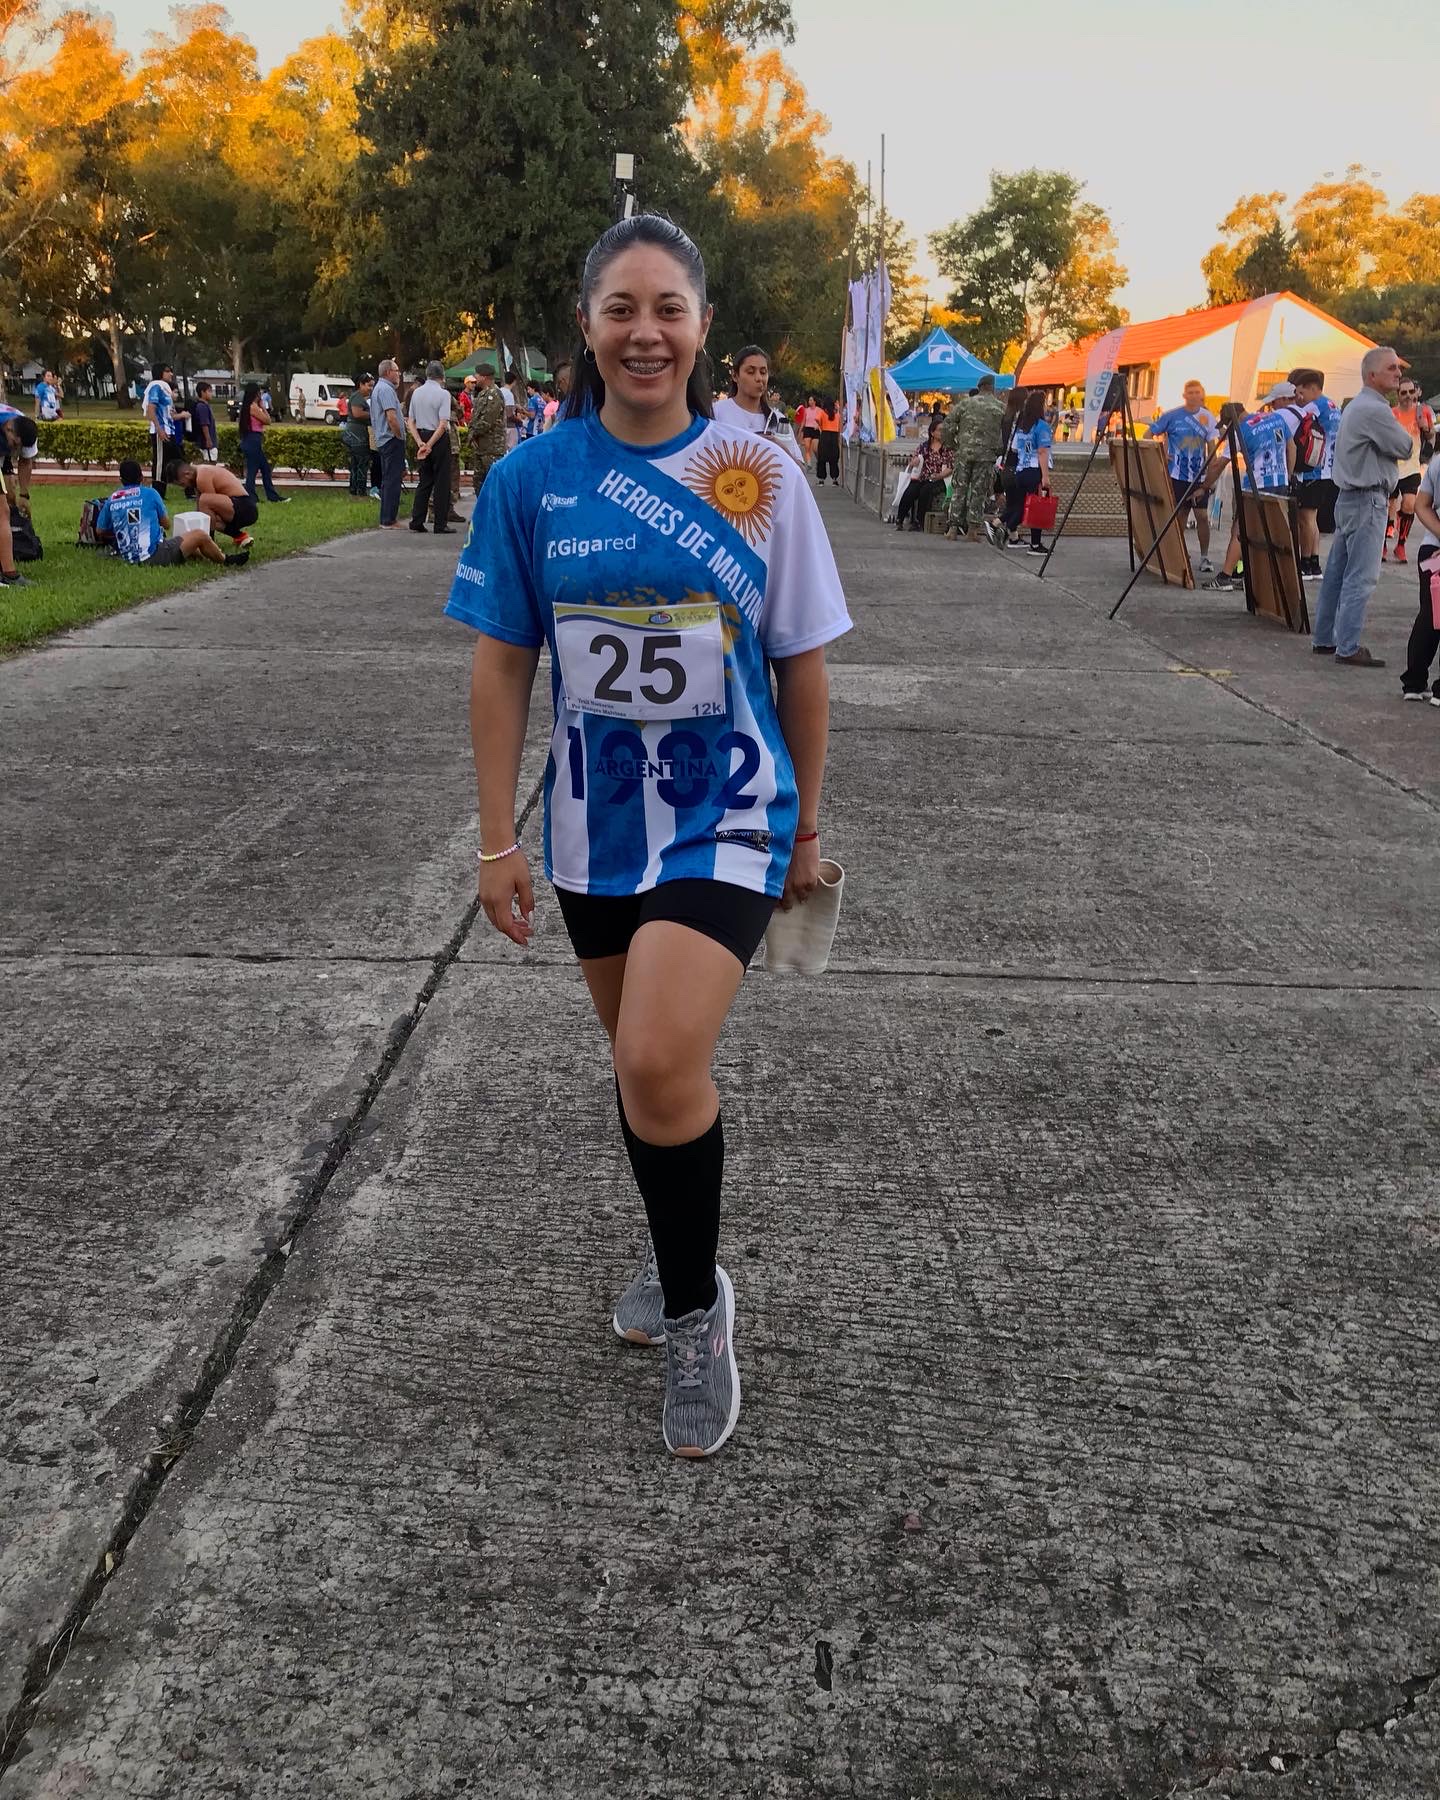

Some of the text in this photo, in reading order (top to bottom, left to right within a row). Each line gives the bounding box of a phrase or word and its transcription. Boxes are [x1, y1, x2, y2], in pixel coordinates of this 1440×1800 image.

[1094, 336, 1121, 397] Gigared
[557, 533, 636, 558] Gigared
[596, 469, 764, 638] HEROES DE MALVIN
[589, 634, 687, 704] 25
[692, 702, 722, 716] 12k
[567, 725, 761, 809] 1982
[594, 759, 719, 780] ARGENTINA
